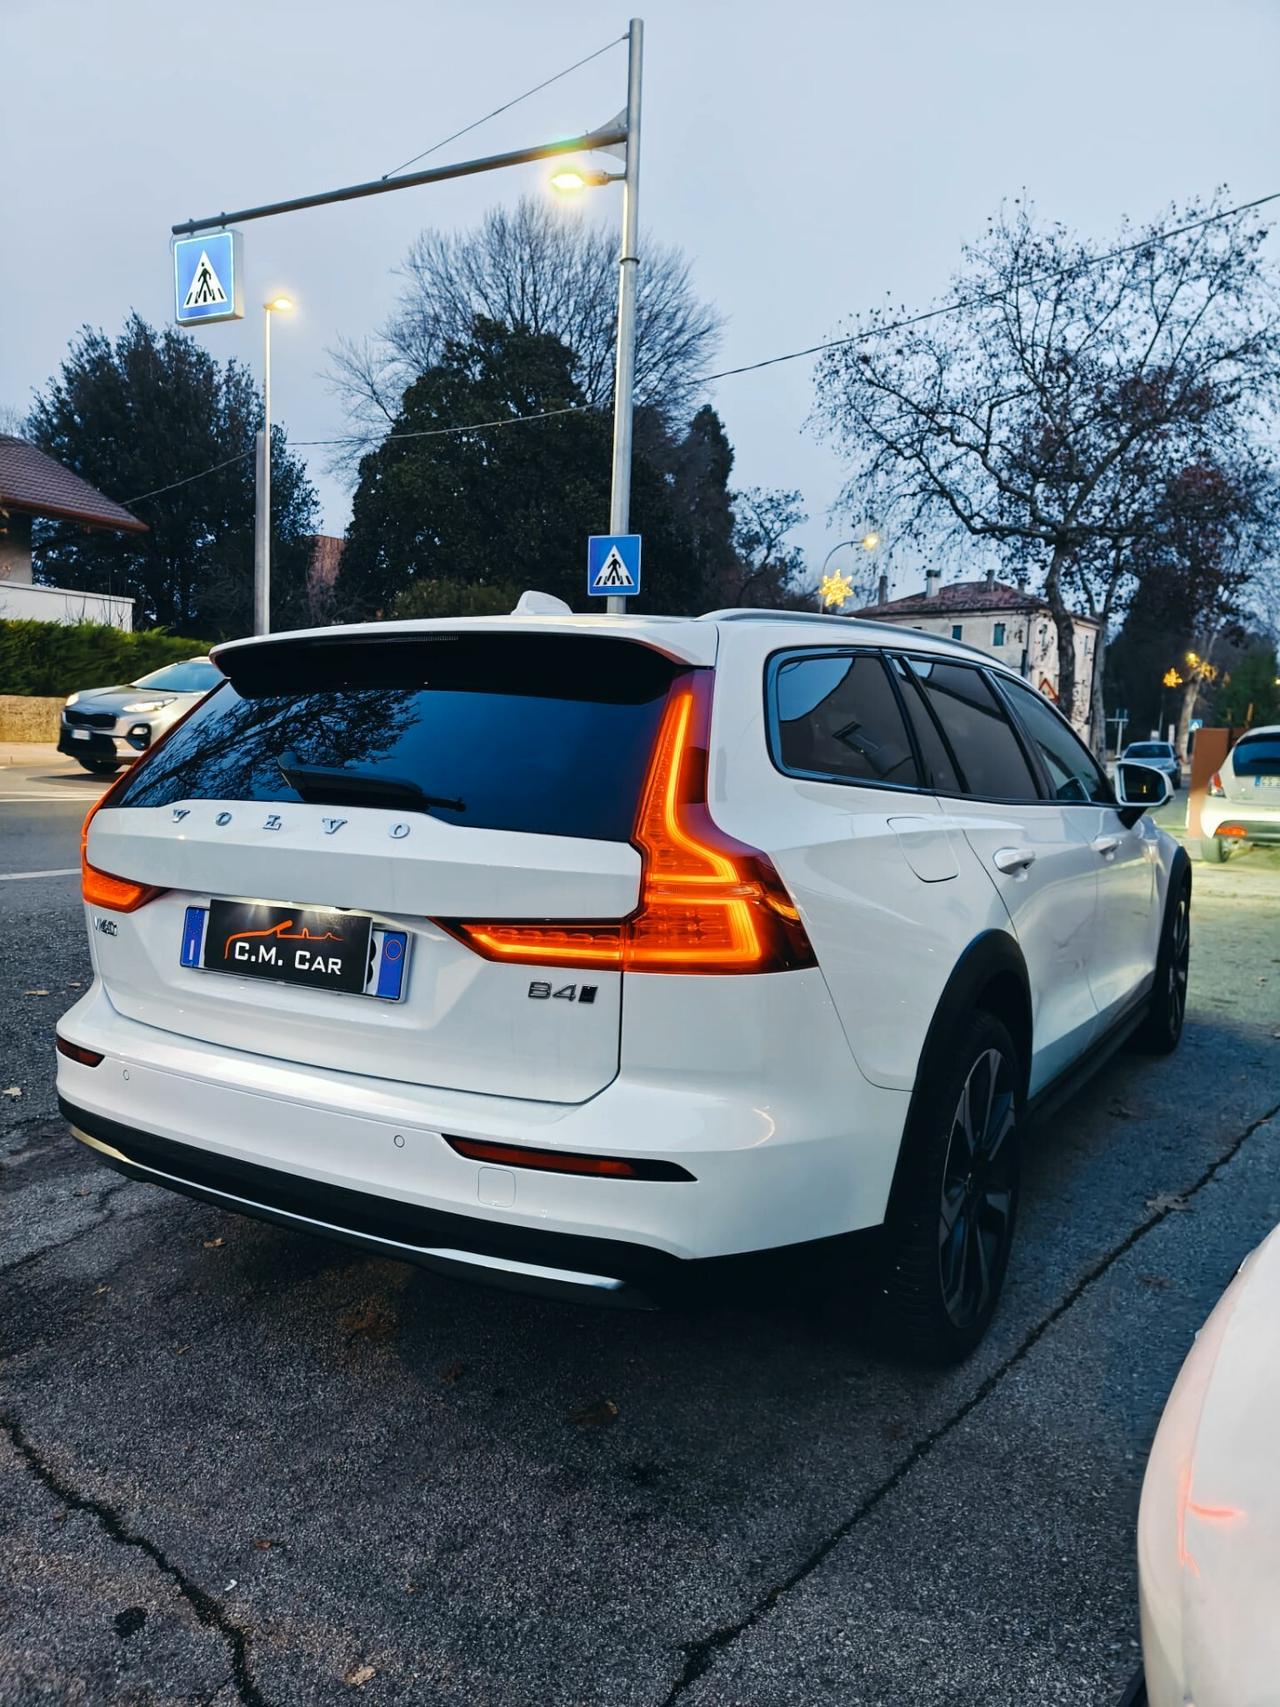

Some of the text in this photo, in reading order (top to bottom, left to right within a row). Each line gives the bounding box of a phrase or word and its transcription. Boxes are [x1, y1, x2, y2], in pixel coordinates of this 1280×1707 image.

[172, 808, 411, 839] VOLVO
[234, 941, 284, 967] C.M.
[527, 981, 577, 1002] B4
